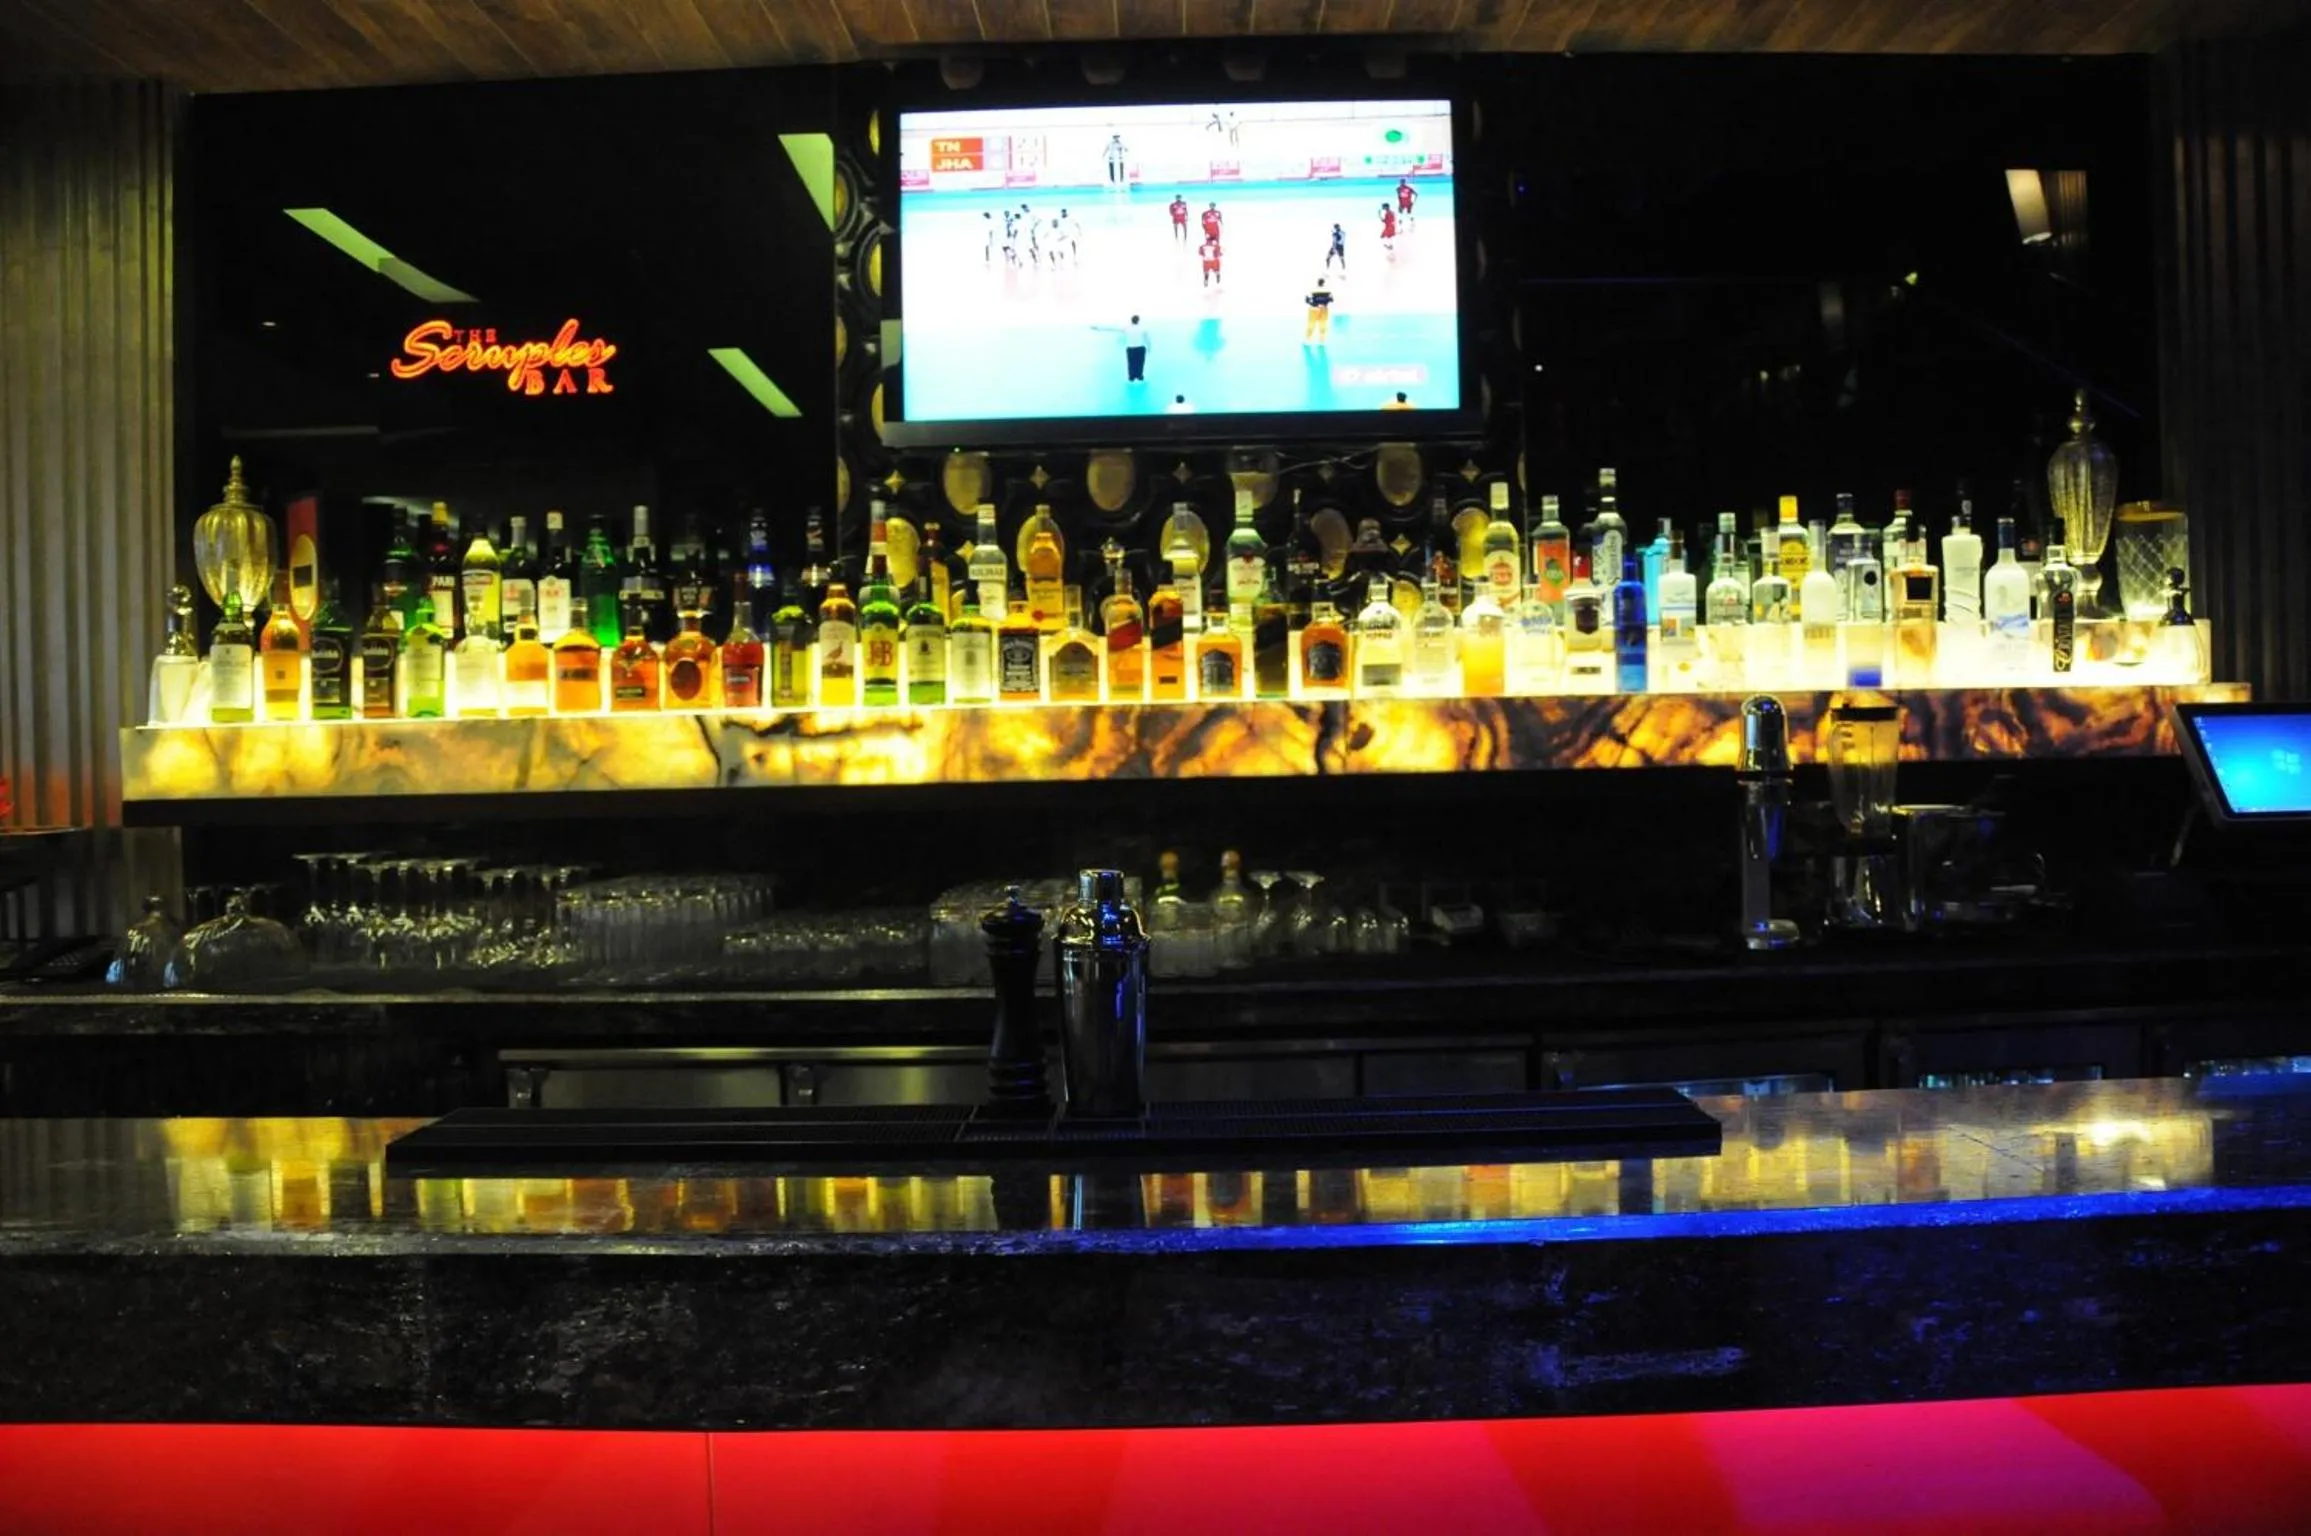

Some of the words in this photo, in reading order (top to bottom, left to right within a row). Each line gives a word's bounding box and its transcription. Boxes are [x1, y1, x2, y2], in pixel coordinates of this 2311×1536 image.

[935, 157, 974, 170] JHA
[454, 328, 497, 344] THE
[524, 368, 614, 395] BAR
